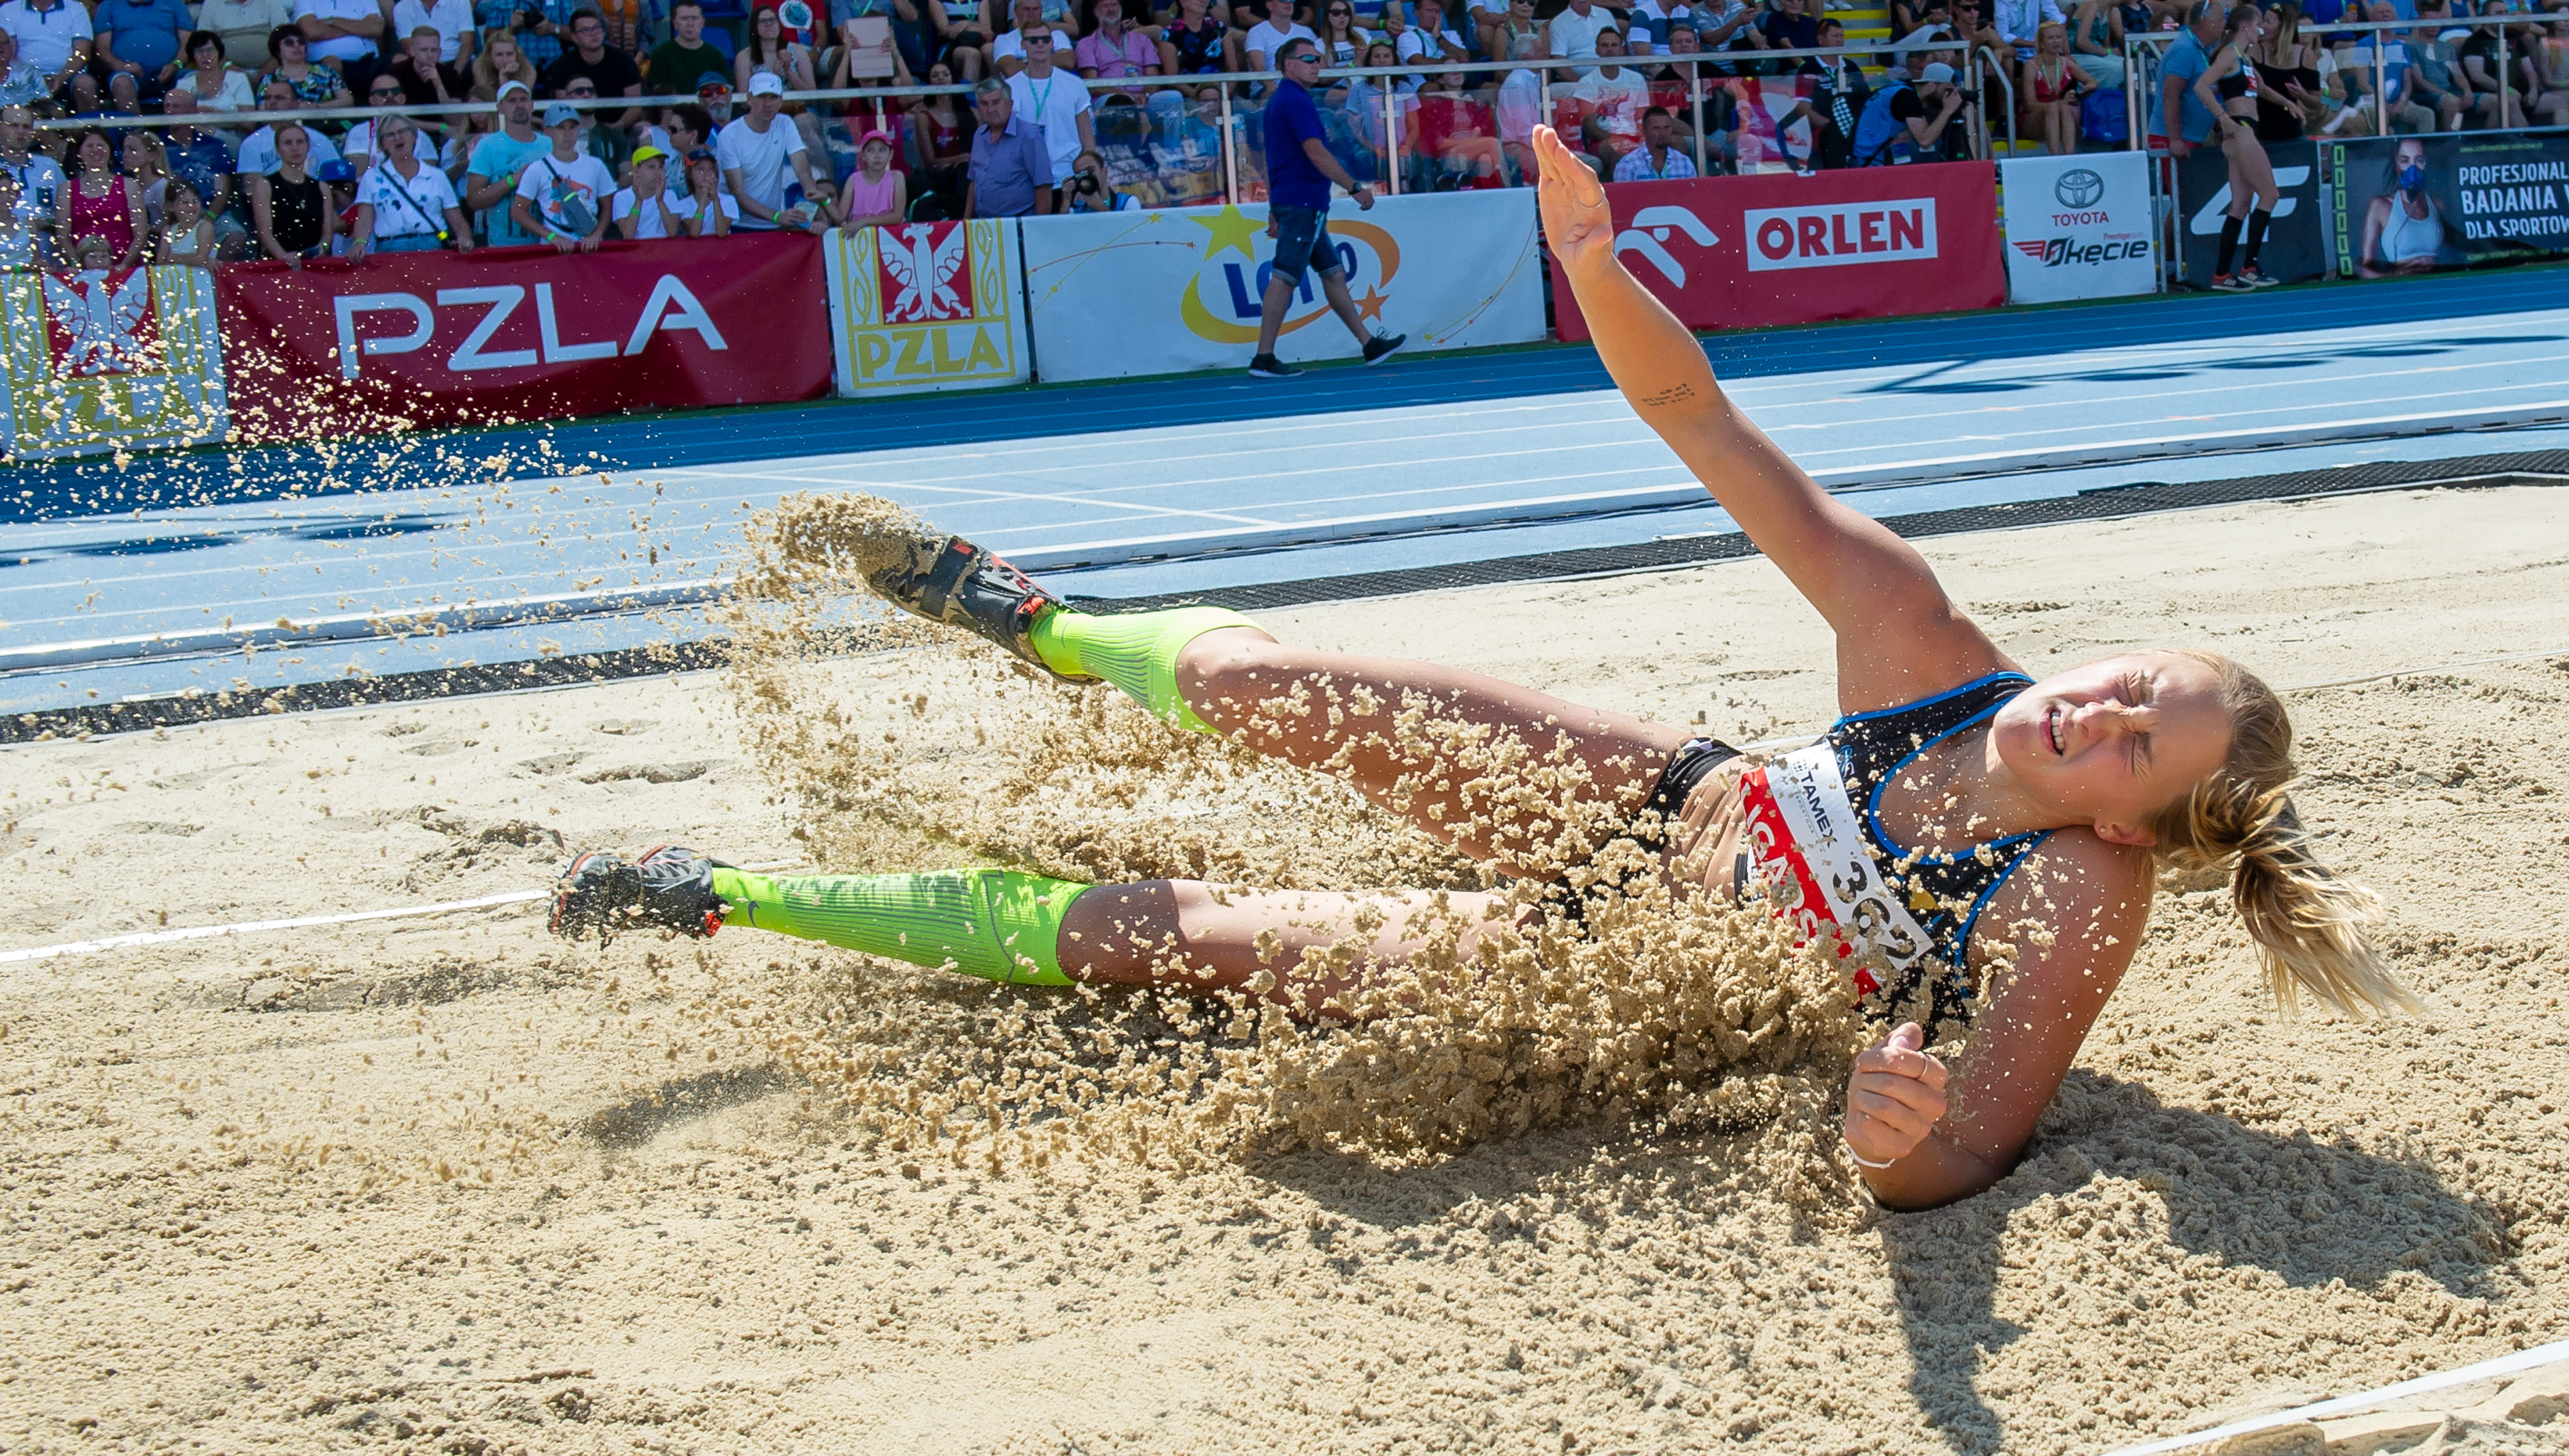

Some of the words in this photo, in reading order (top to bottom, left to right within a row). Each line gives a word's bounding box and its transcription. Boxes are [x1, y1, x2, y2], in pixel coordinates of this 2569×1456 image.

[2459, 161, 2569, 185] PROFESJONAL
[2052, 211, 2109, 227] TOYOTA
[2461, 185, 2558, 215] BADANIA
[1757, 208, 1924, 260] ORLEN
[2465, 220, 2498, 239] DLA
[334, 273, 728, 380] PZLA
[857, 325, 1005, 378] PZLA
[22, 376, 196, 439] PZLA
[1801, 770, 1837, 848] TAMEX
[1833, 861, 1917, 959] 362
